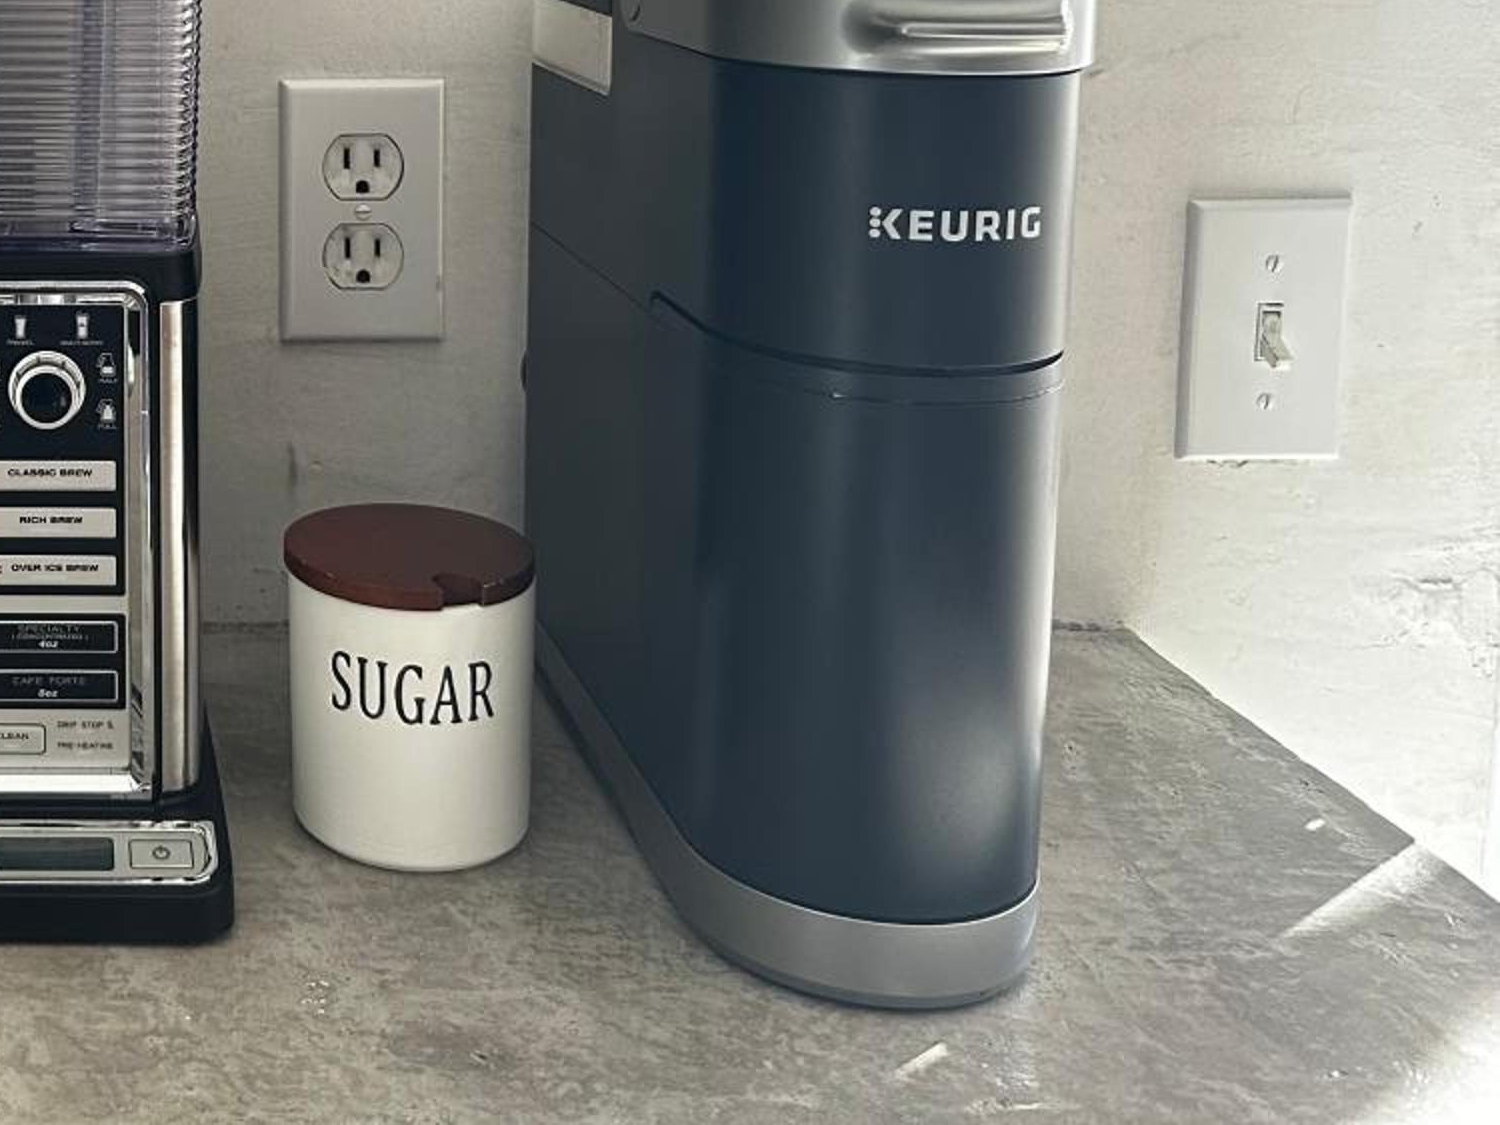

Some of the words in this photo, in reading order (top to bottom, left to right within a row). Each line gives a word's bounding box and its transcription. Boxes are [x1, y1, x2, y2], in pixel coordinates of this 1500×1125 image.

[868, 206, 1041, 242] KEURIG
[7, 468, 57, 477] CLASSIC
[59, 468, 93, 477] BREW
[19, 516, 48, 524] RICH
[49, 516, 83, 524] BREW
[11, 564, 42, 573] OVER
[44, 564, 63, 573] ICE
[65, 564, 100, 573] BREW
[331, 651, 494, 725] SUGAR
